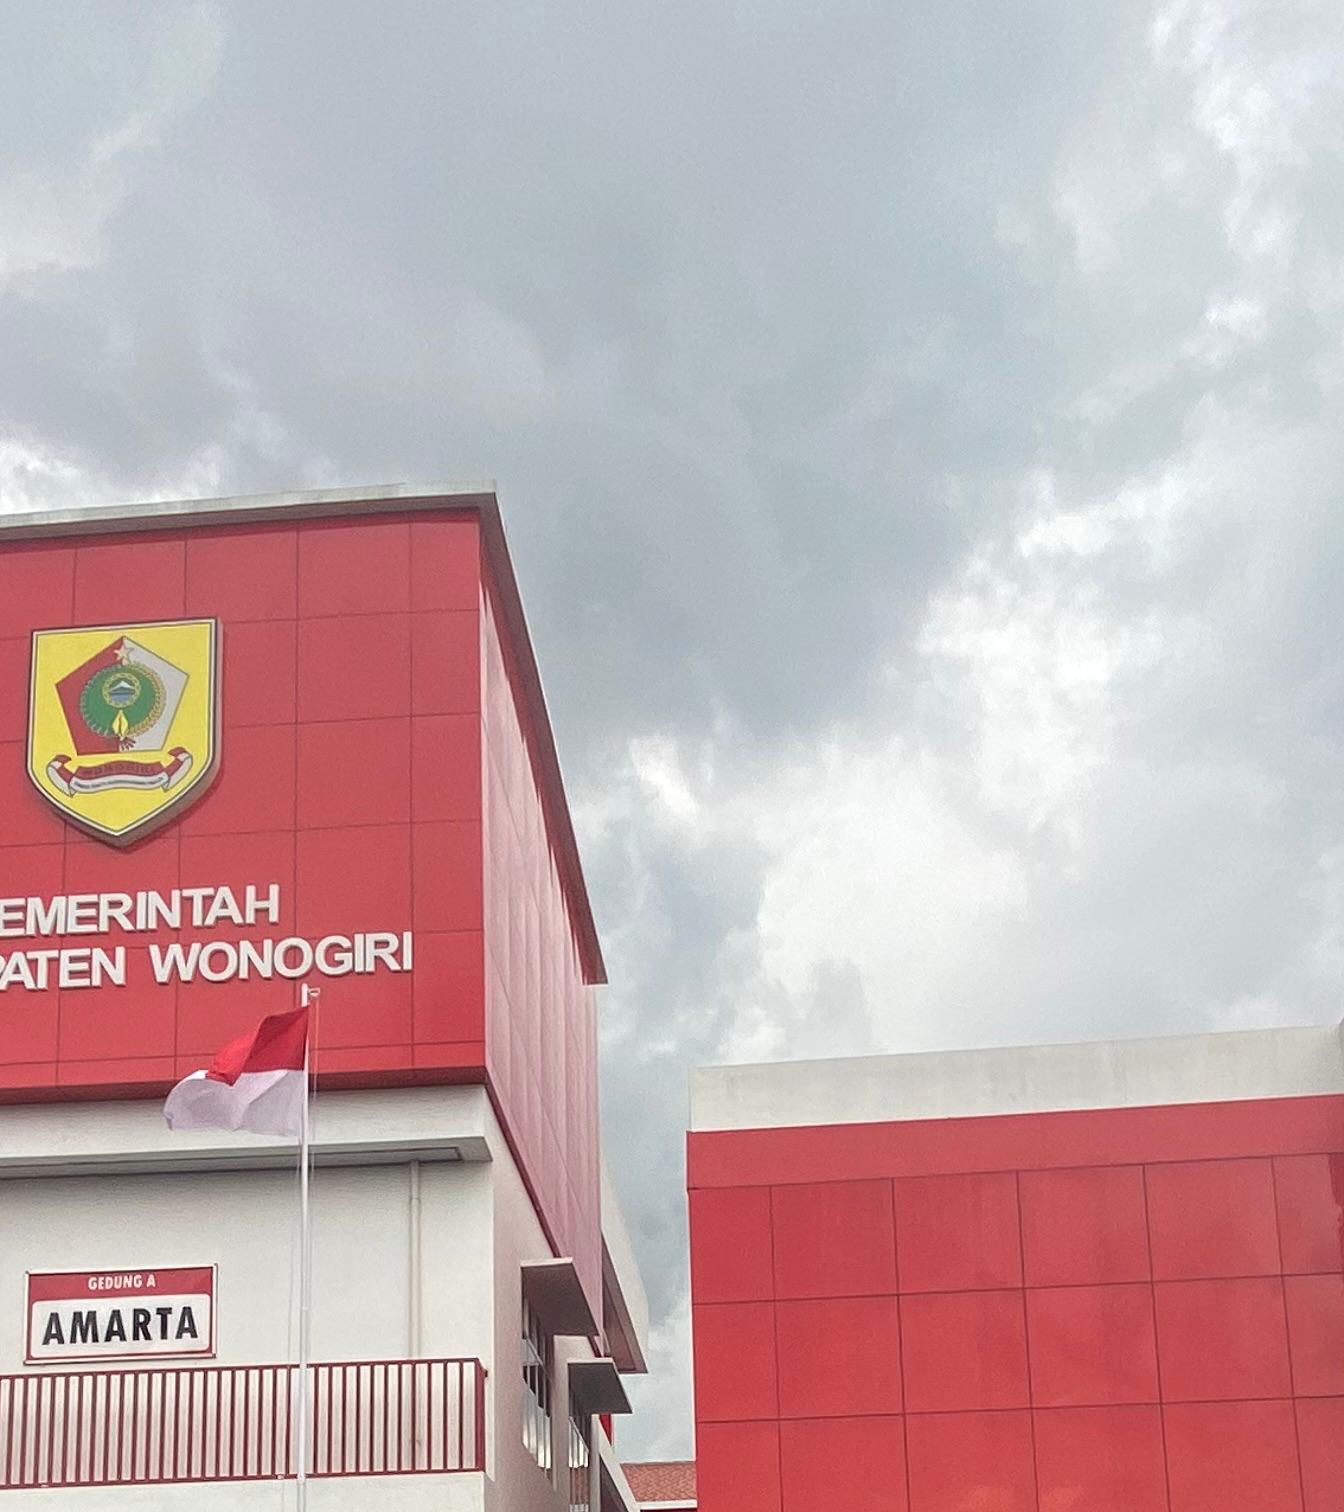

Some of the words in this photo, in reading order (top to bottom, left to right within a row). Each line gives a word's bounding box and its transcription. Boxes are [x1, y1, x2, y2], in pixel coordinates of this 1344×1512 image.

[149, 931, 413, 985] WONOGIRI
[88, 1275, 142, 1290] GEDUNG
[146, 1274, 156, 1288] A
[42, 1306, 199, 1346] AMARTA
